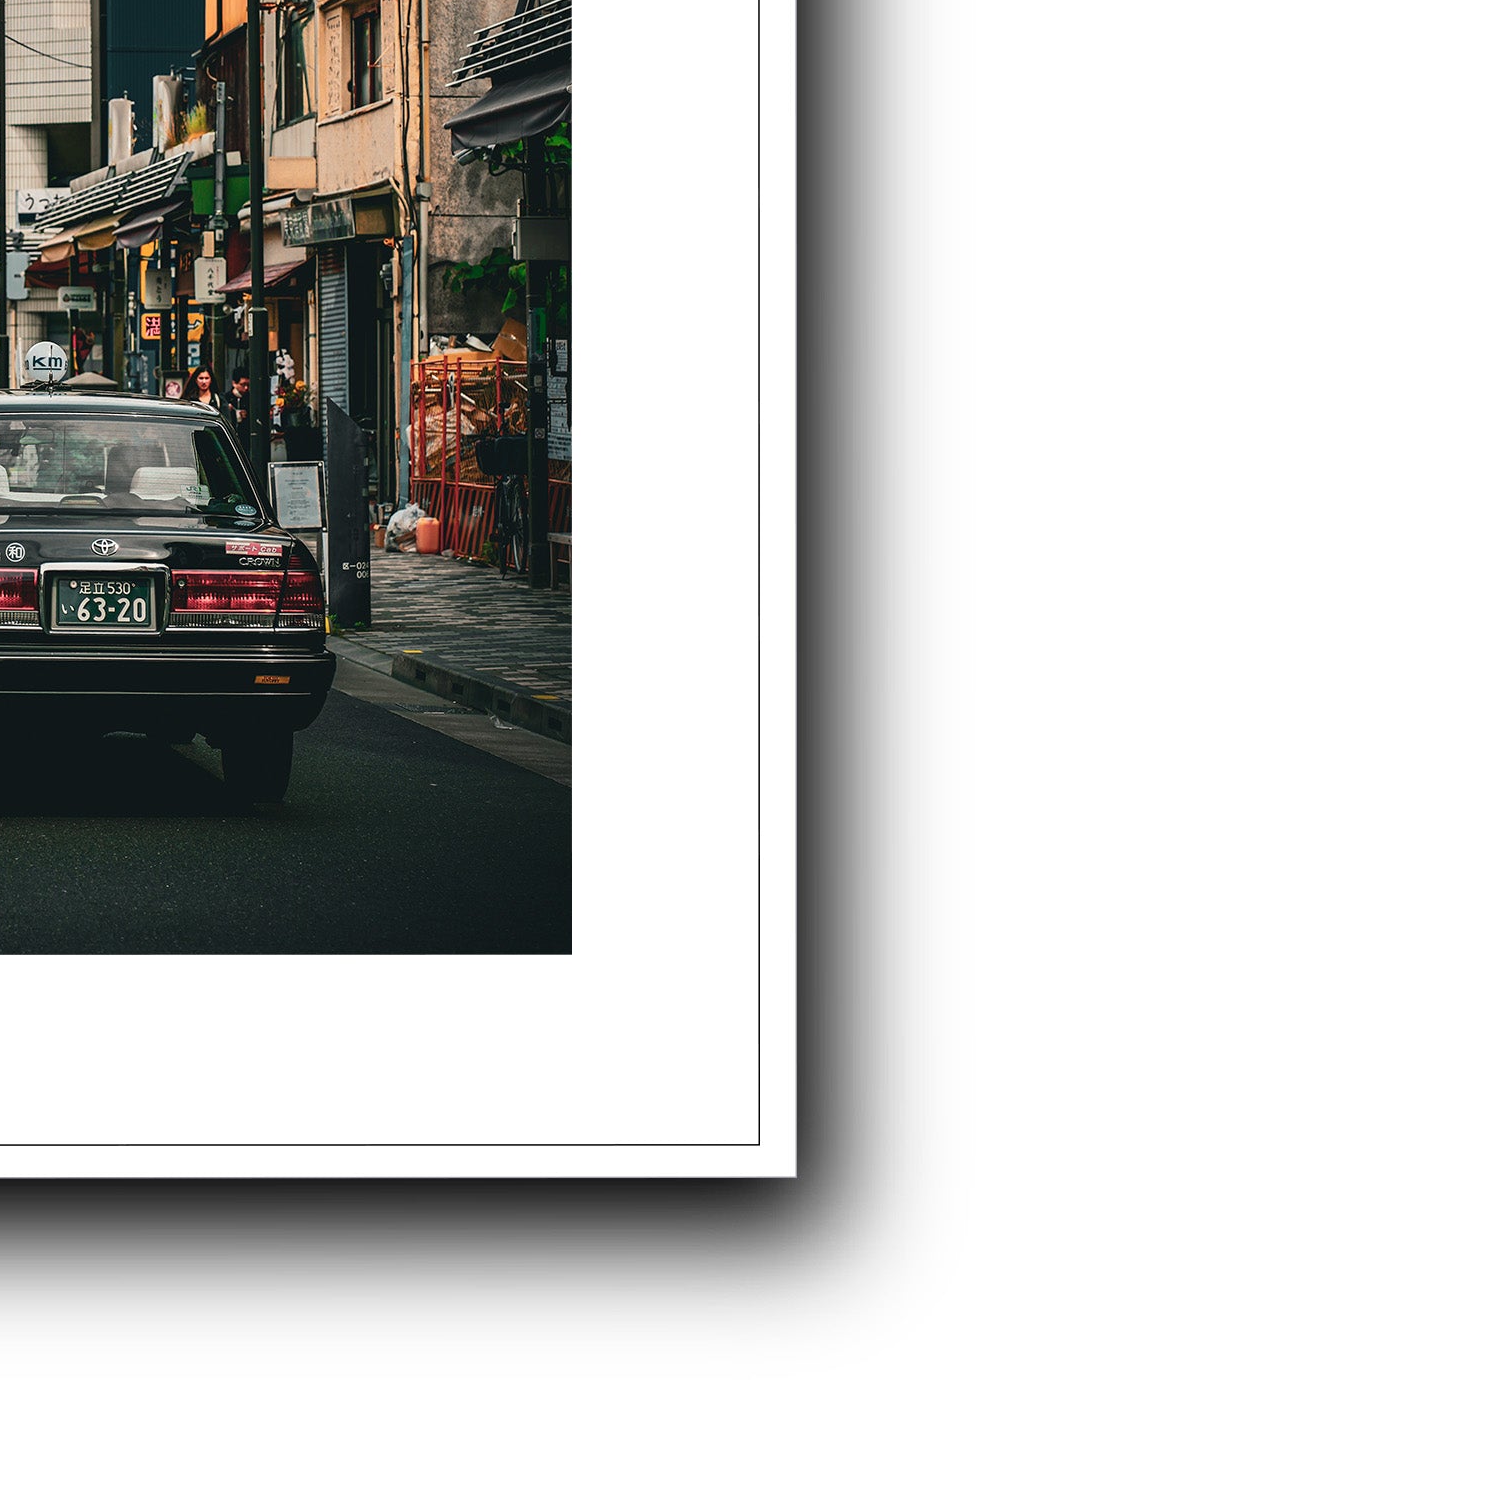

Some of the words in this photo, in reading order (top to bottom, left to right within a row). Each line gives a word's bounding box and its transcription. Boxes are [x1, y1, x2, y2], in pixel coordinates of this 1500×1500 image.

[7, 544, 24, 560] 和
[260, 546, 277, 554] Cab
[239, 557, 281, 567] CROWN
[77, 597, 147, 622] 63-20
